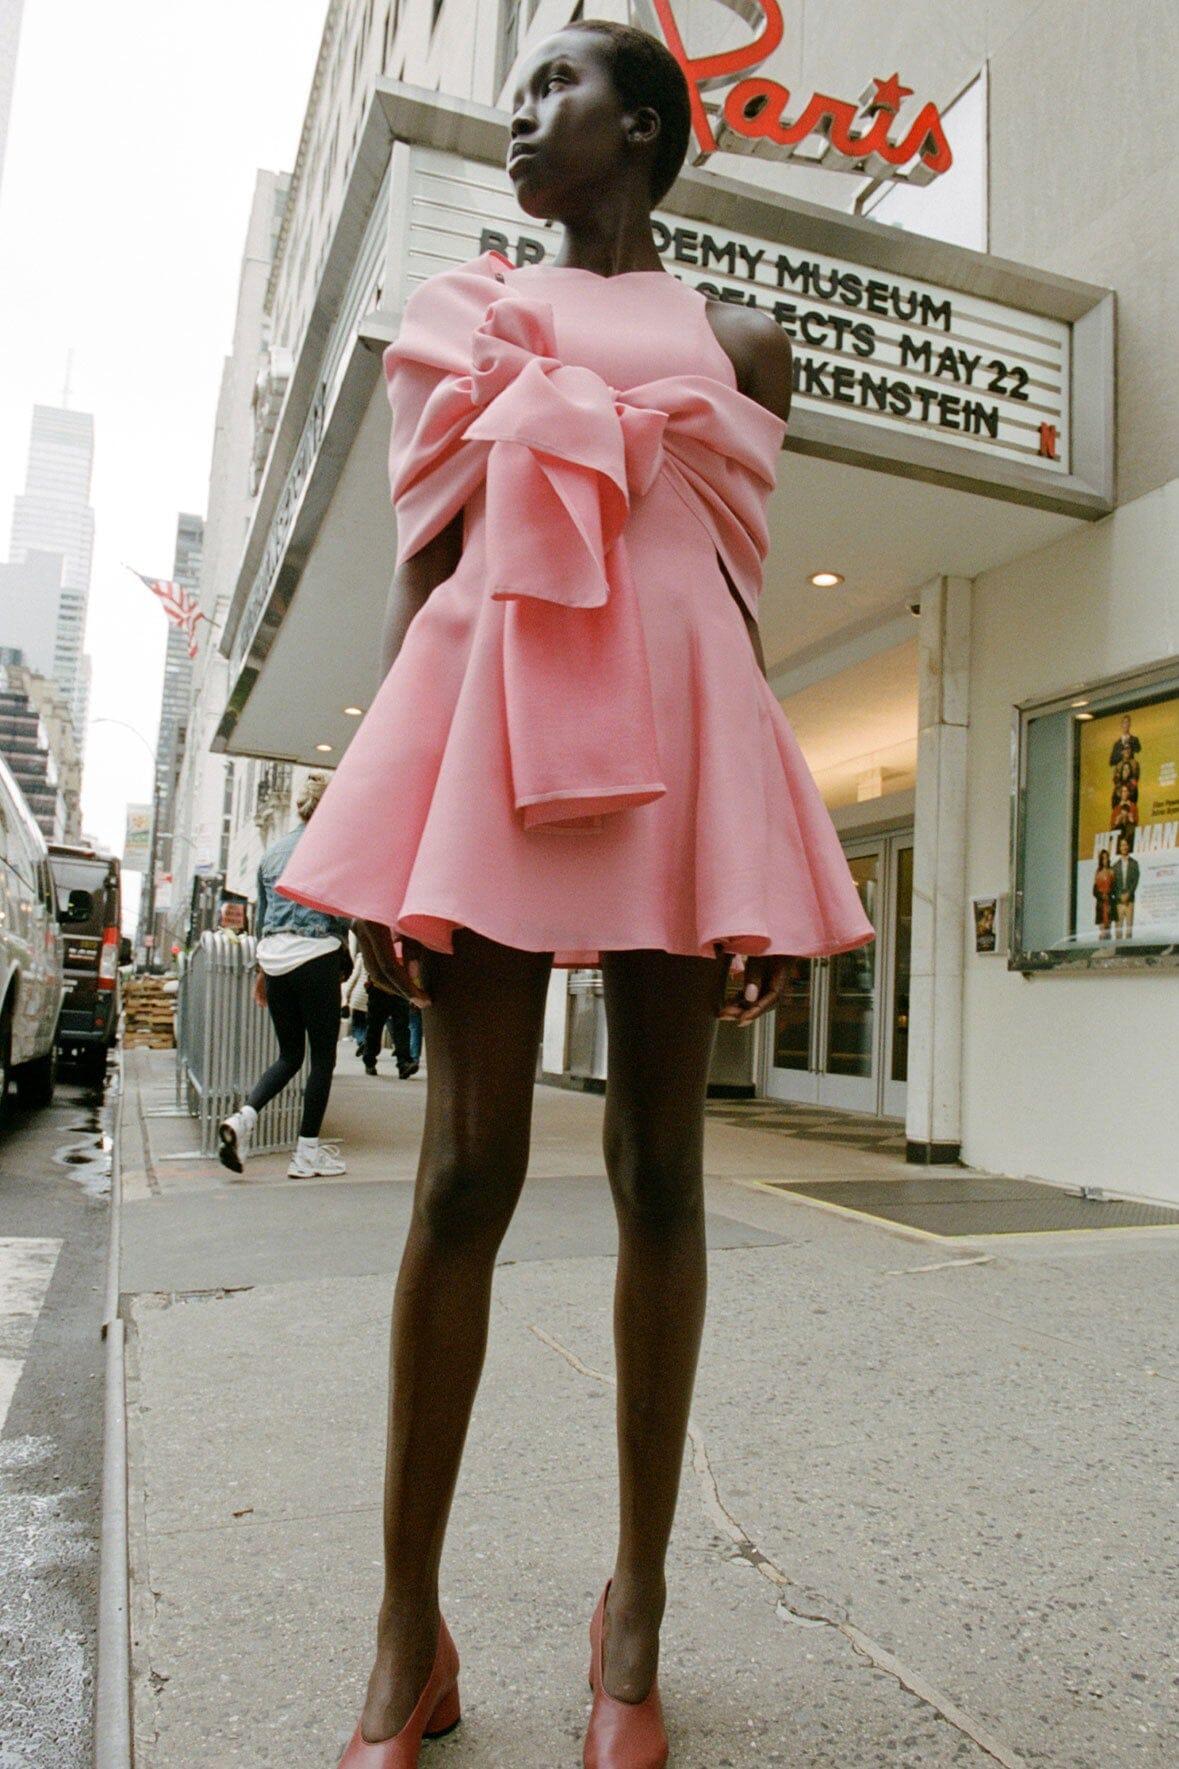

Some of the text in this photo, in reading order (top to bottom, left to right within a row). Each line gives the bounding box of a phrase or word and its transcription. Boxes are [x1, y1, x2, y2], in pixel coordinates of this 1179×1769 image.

[655, 0, 953, 173] Paris
[480, 219, 952, 332] BR DEMY MUSEUM
[790, 356, 1000, 439] KENSTEIN
[899, 334, 982, 386] MAY
[987, 359, 1030, 401] 22
